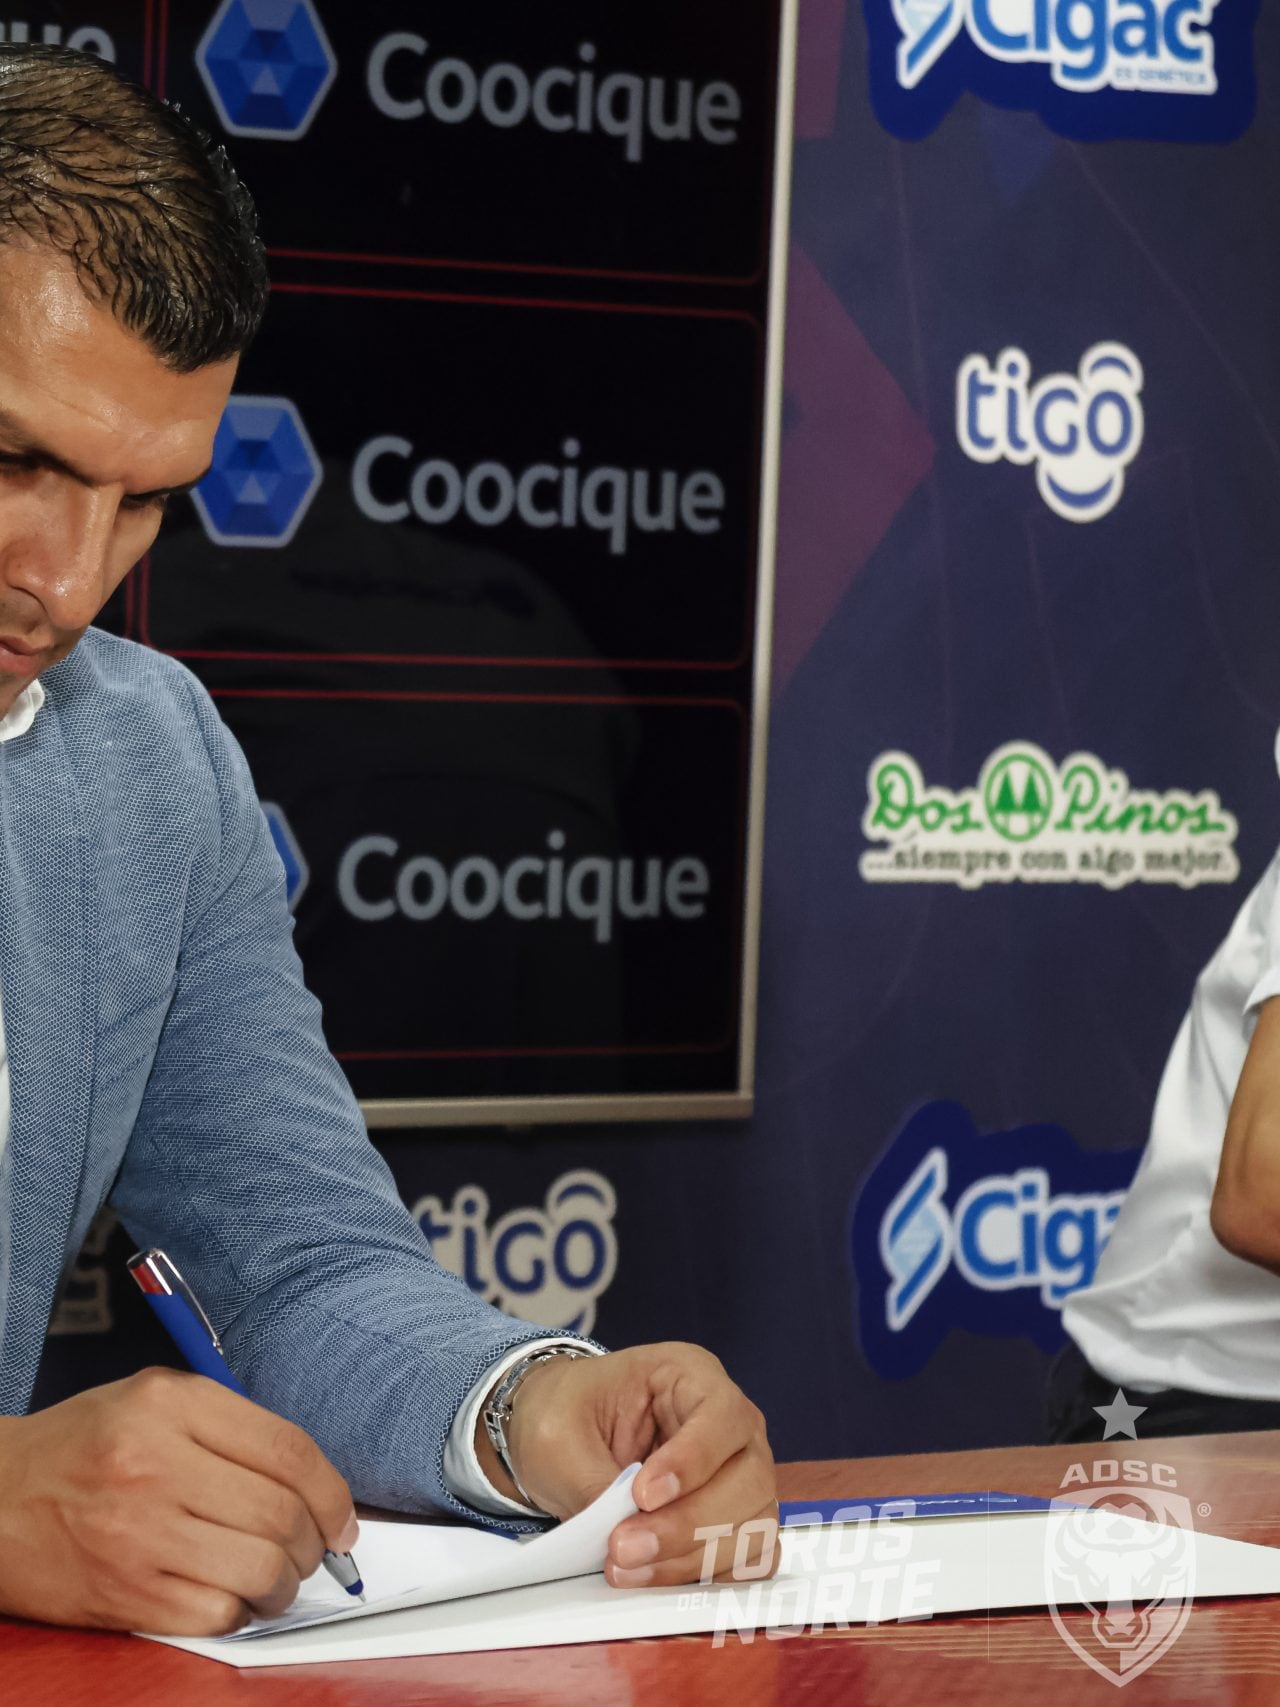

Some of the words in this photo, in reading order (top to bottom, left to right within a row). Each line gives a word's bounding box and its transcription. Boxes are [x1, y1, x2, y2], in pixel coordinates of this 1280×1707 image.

[367, 33, 740, 162] Coocique
[351, 436, 724, 554] Coocique
[872, 763, 984, 832] Dos
[1055, 764, 1225, 833] Pinos
[337, 830, 708, 943] Coocique
[1021, 851, 1068, 871] con
[1079, 844, 1135, 876] algo
